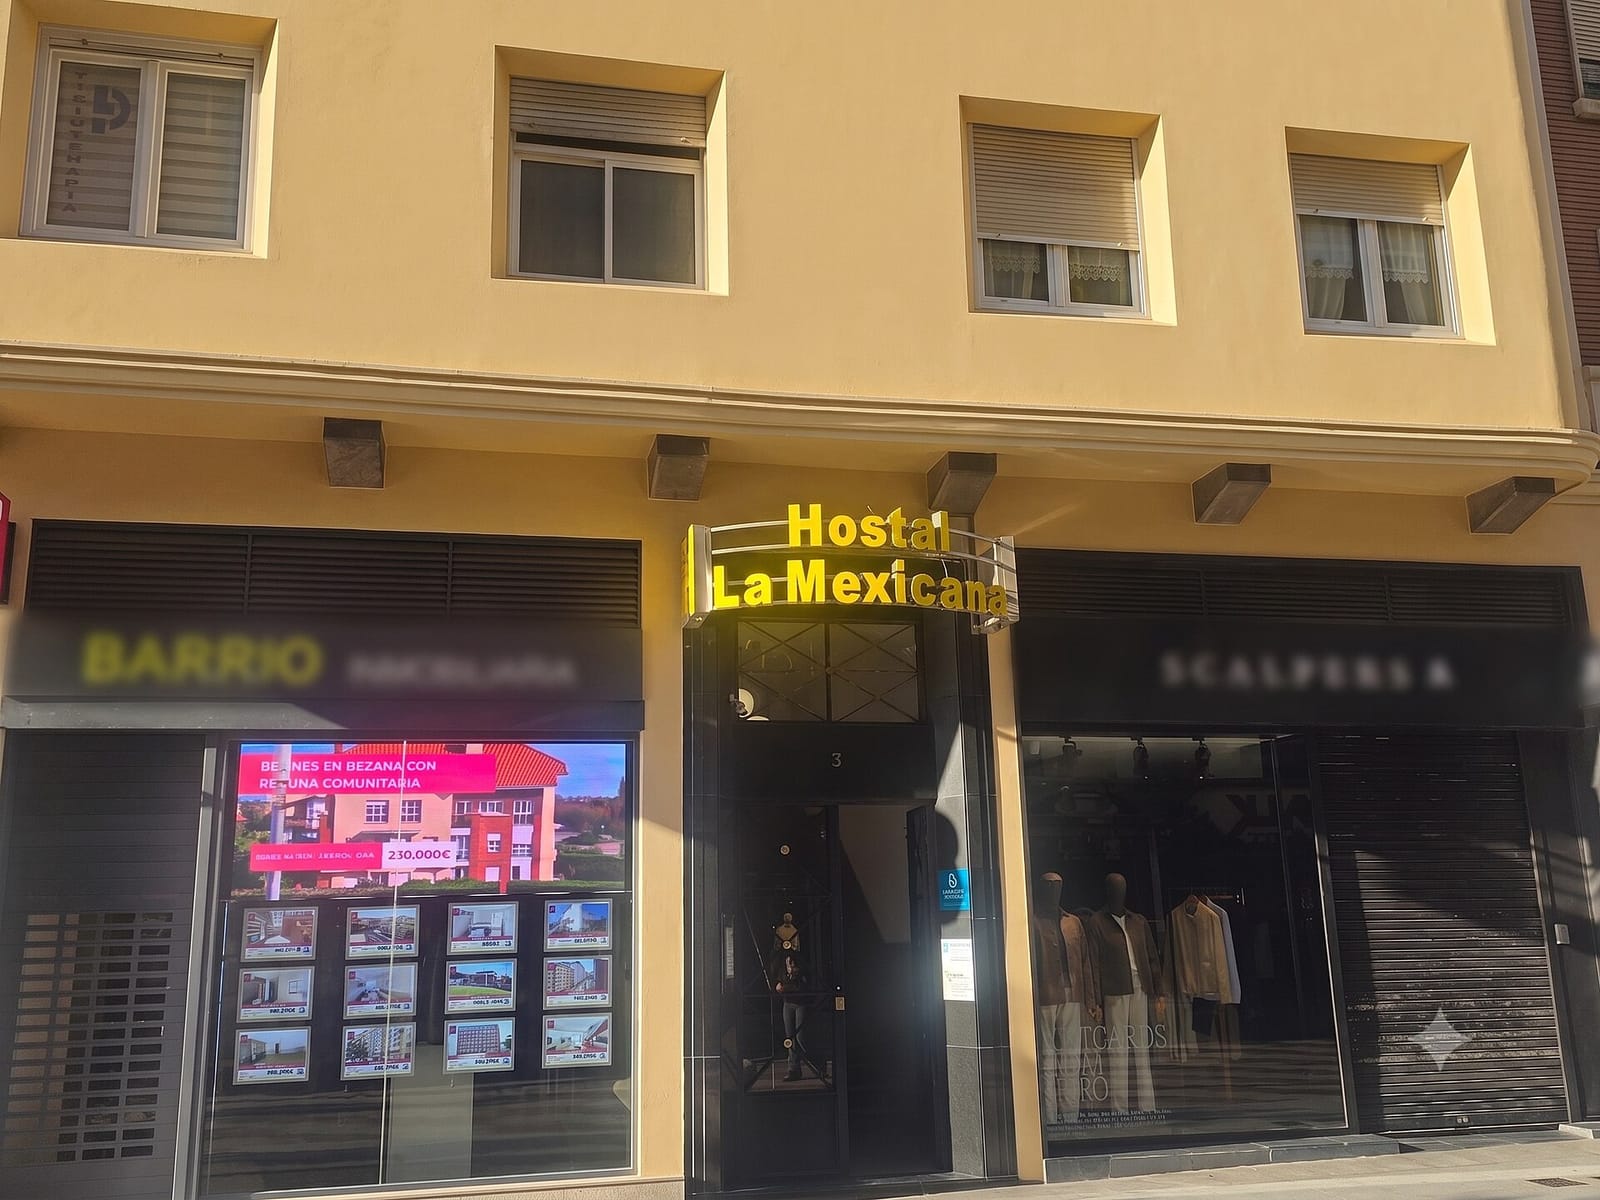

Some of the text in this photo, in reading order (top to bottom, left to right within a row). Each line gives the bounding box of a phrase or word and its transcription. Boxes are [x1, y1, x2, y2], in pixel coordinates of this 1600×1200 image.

[787, 503, 950, 552] Hostal
[712, 558, 1008, 616] La Mexicana
[324, 761, 342, 771] EN
[346, 761, 402, 772] BEZANA
[406, 761, 437, 771] CON
[831, 752, 842, 768] 3
[322, 778, 421, 789] COMUNITARIA
[388, 849, 451, 860] 230.000€
